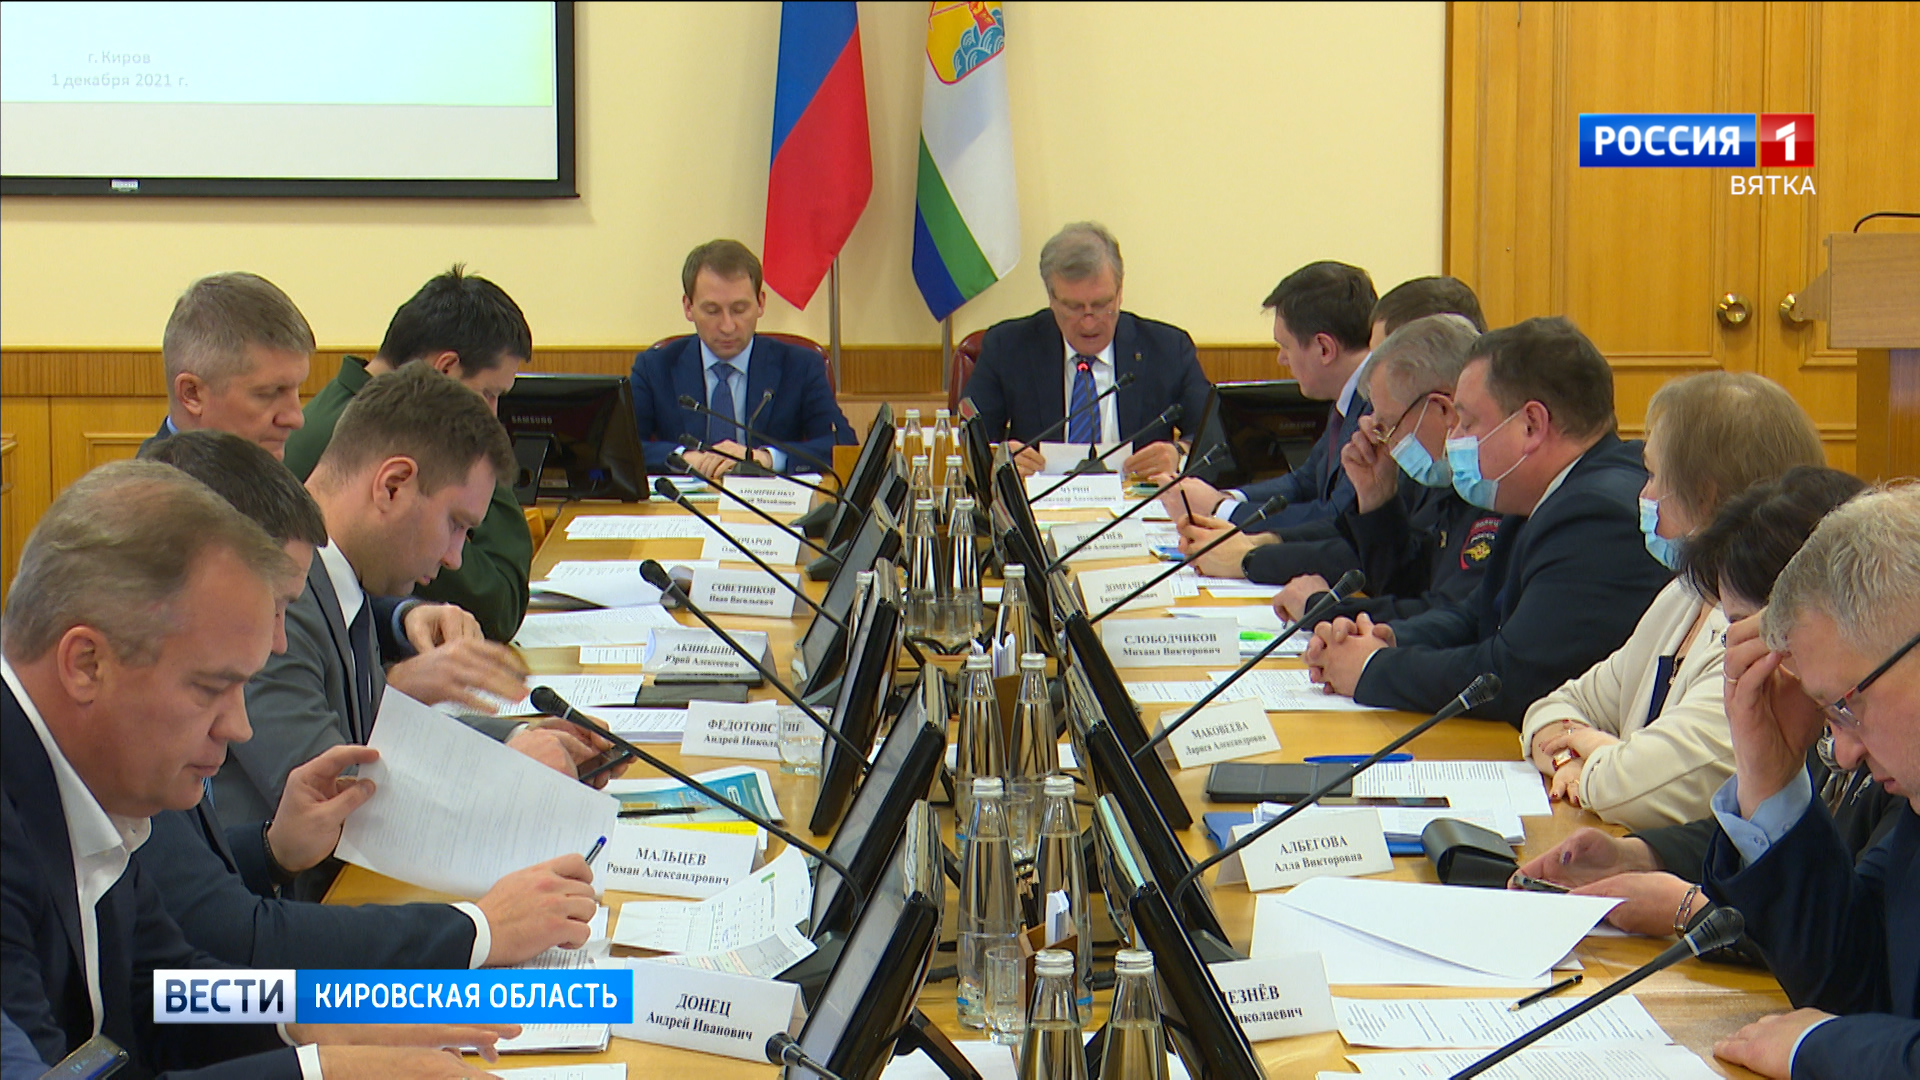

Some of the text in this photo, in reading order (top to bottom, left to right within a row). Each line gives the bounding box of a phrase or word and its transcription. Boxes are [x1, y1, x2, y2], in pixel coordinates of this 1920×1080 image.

[102, 51, 151, 67] Киров
[52, 73, 59, 86] 1
[63, 72, 130, 89] декабря
[135, 73, 172, 86] 2021
[711, 583, 776, 595] СОВЕТНИКОВ
[1124, 633, 1217, 644] СЛОБОДЧИКОВ
[1122, 647, 1221, 656] Михаил Викторович
[1191, 721, 1249, 739] МАКОВЕЕВА
[704, 734, 739, 746] Андрей
[1279, 834, 1349, 855] АЛБЕГОВА
[635, 847, 707, 866] МАЛЬЦЕВ
[1274, 852, 1363, 873] Алла Викторовна
[606, 861, 730, 886] Роман Александрович
[675, 993, 732, 1018] ДОНЕЦ
[1235, 1007, 1303, 1025] иколаевич
[646, 1010, 753, 1042] Андрей Иванович
